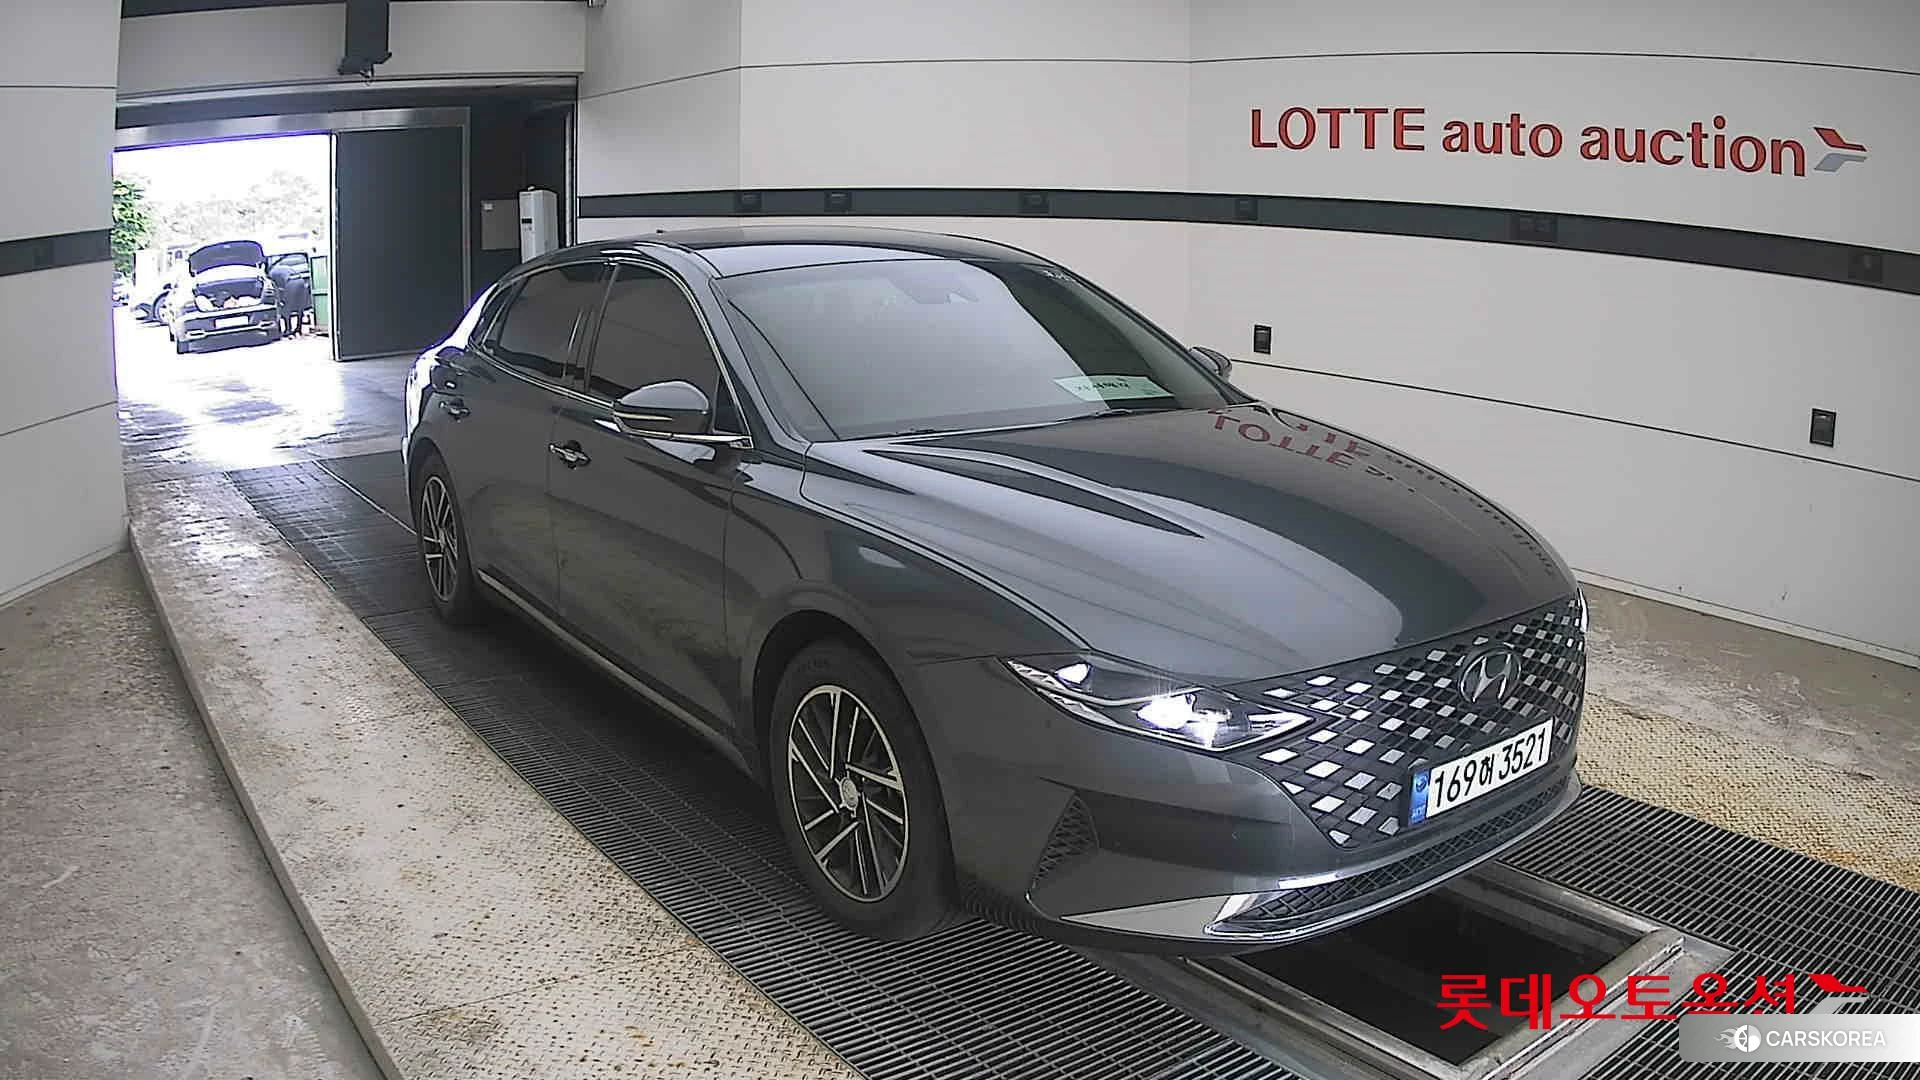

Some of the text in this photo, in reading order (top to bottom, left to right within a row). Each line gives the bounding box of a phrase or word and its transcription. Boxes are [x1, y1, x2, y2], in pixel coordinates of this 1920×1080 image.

[1250, 106, 1807, 177] LOTTE auto auction
[1434, 727, 1547, 808] 169허 3521
